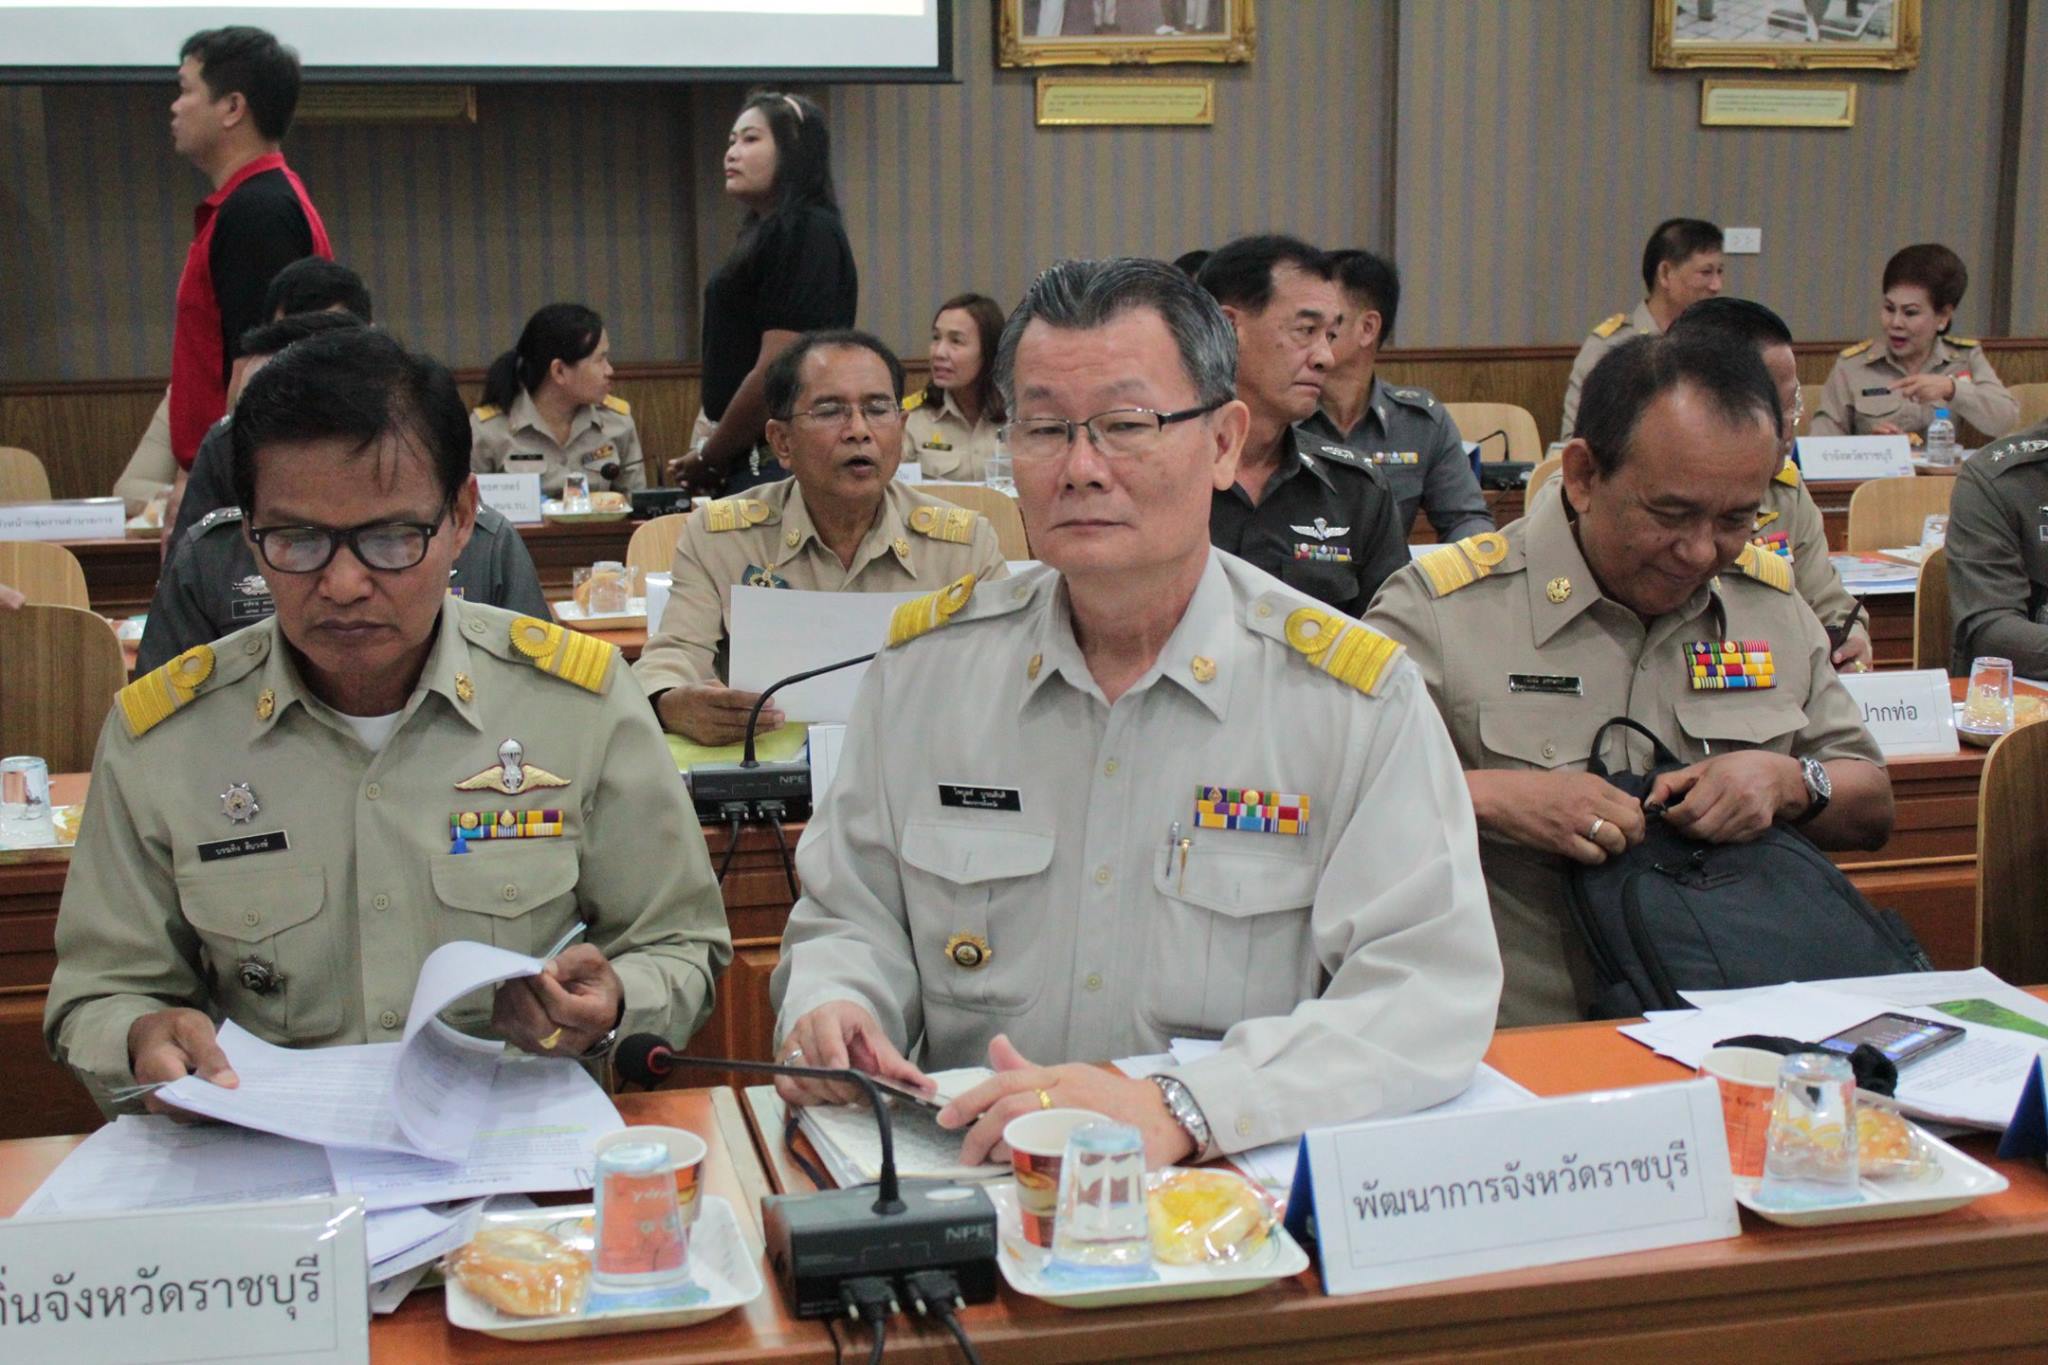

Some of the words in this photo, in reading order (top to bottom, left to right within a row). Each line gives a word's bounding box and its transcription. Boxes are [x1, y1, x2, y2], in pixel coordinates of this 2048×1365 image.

[779, 774, 807, 785] NPE
[1352, 1139, 1691, 1221] พัฒนาการจังหวัดราชบุรี
[944, 1222, 994, 1243] NPE
